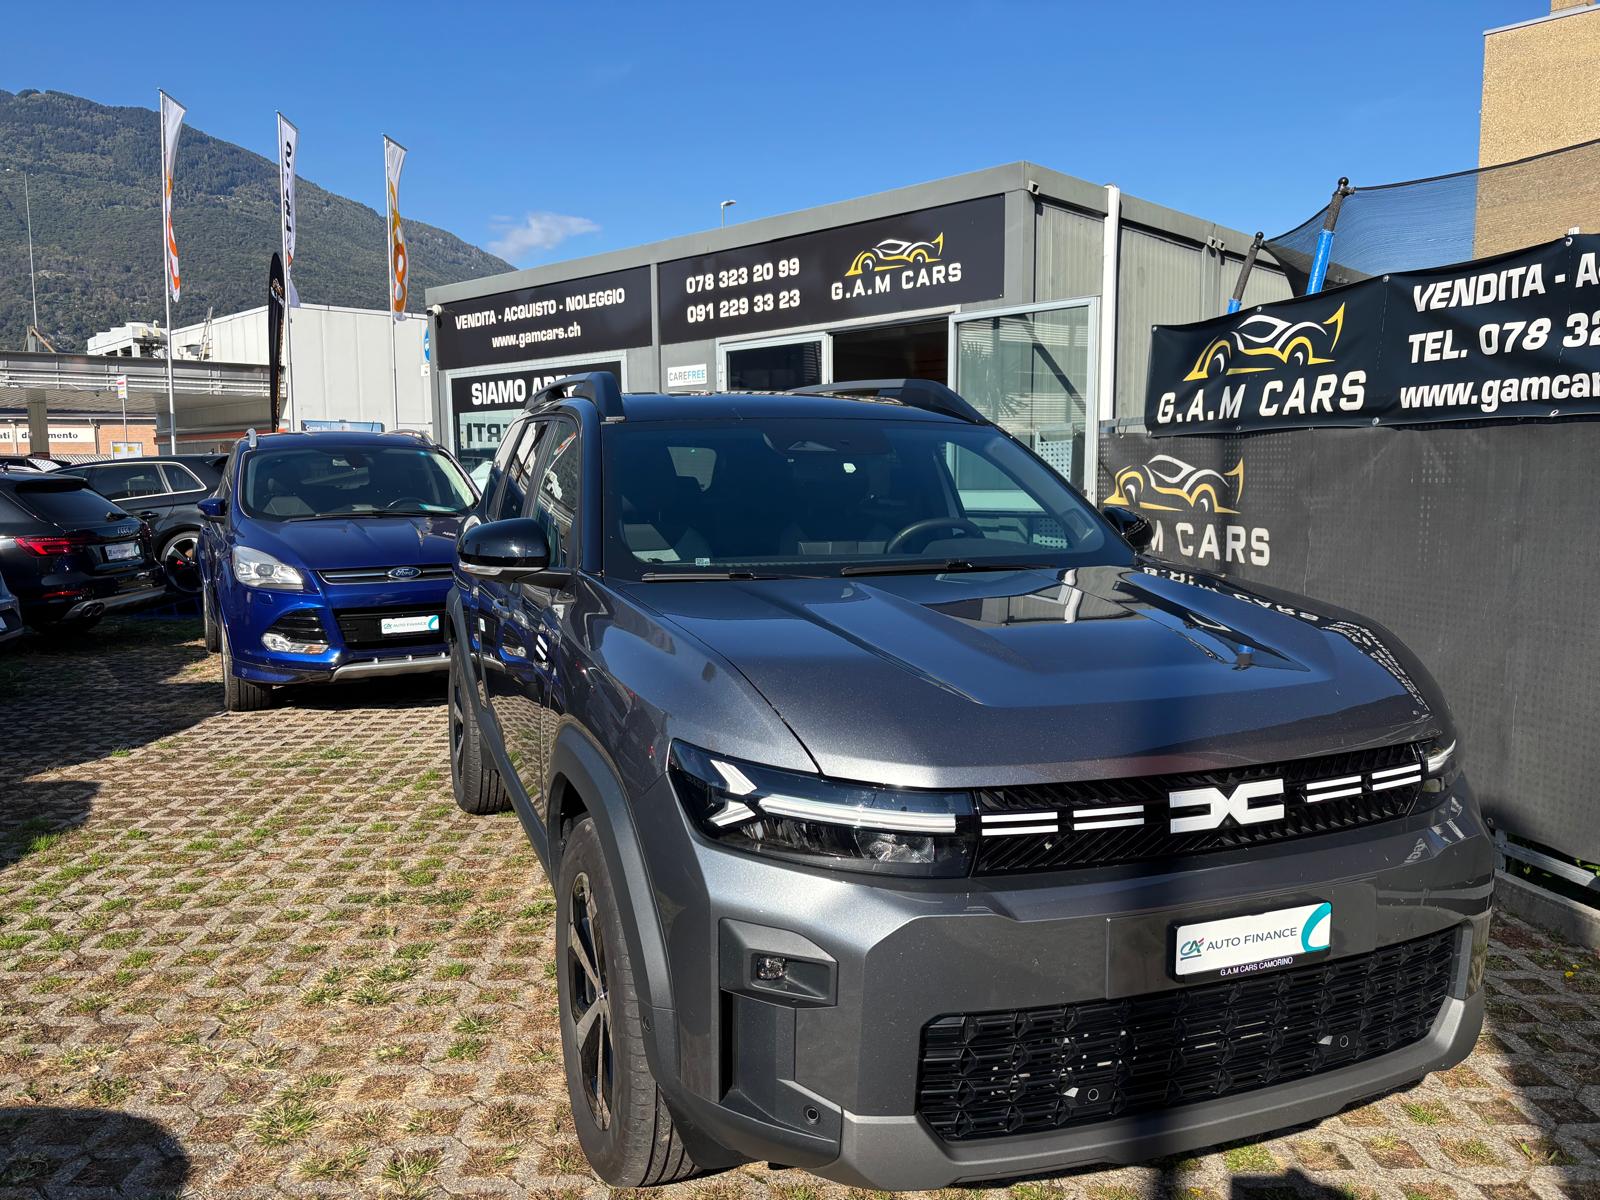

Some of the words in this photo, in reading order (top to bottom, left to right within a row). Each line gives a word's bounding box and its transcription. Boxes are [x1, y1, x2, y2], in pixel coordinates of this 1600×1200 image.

[686, 273, 715, 294] 078
[718, 267, 748, 289] 323
[752, 262, 774, 283] 20
[778, 258, 800, 278] 99
[830, 276, 890, 300] G.A.M
[901, 262, 962, 289] CARS
[1413, 263, 1545, 313] VENDITA
[1554, 273, 1566, 284] -
[1575, 252, 1600, 288] A
[455, 310, 496, 330] VENDITA
[504, 300, 557, 322] ACQUISTO
[565, 287, 625, 312] NOLEGGIO
[686, 303, 714, 324] 091
[718, 297, 749, 318] 229
[753, 293, 774, 313] 33
[778, 289, 800, 309] 23
[492, 322, 582, 348] www.gamcars.ch
[1408, 328, 1468, 364] TEL.
[1479, 317, 1551, 356] 078
[472, 378, 526, 406] SIAMO
[669, 370, 706, 381] CAREFREE
[1156, 384, 1247, 424] G.A.M
[1259, 370, 1367, 417] CARS
[1175, 522, 1270, 566] CARS
[396, 568, 414, 576] Ford
[1206, 937, 1241, 952] AUTO
[1244, 927, 1298, 945] FINANCE
[1220, 966, 1238, 977] G.A.M
[1240, 964, 1258, 974] CARS
[1258, 956, 1294, 970] CAMORINO
